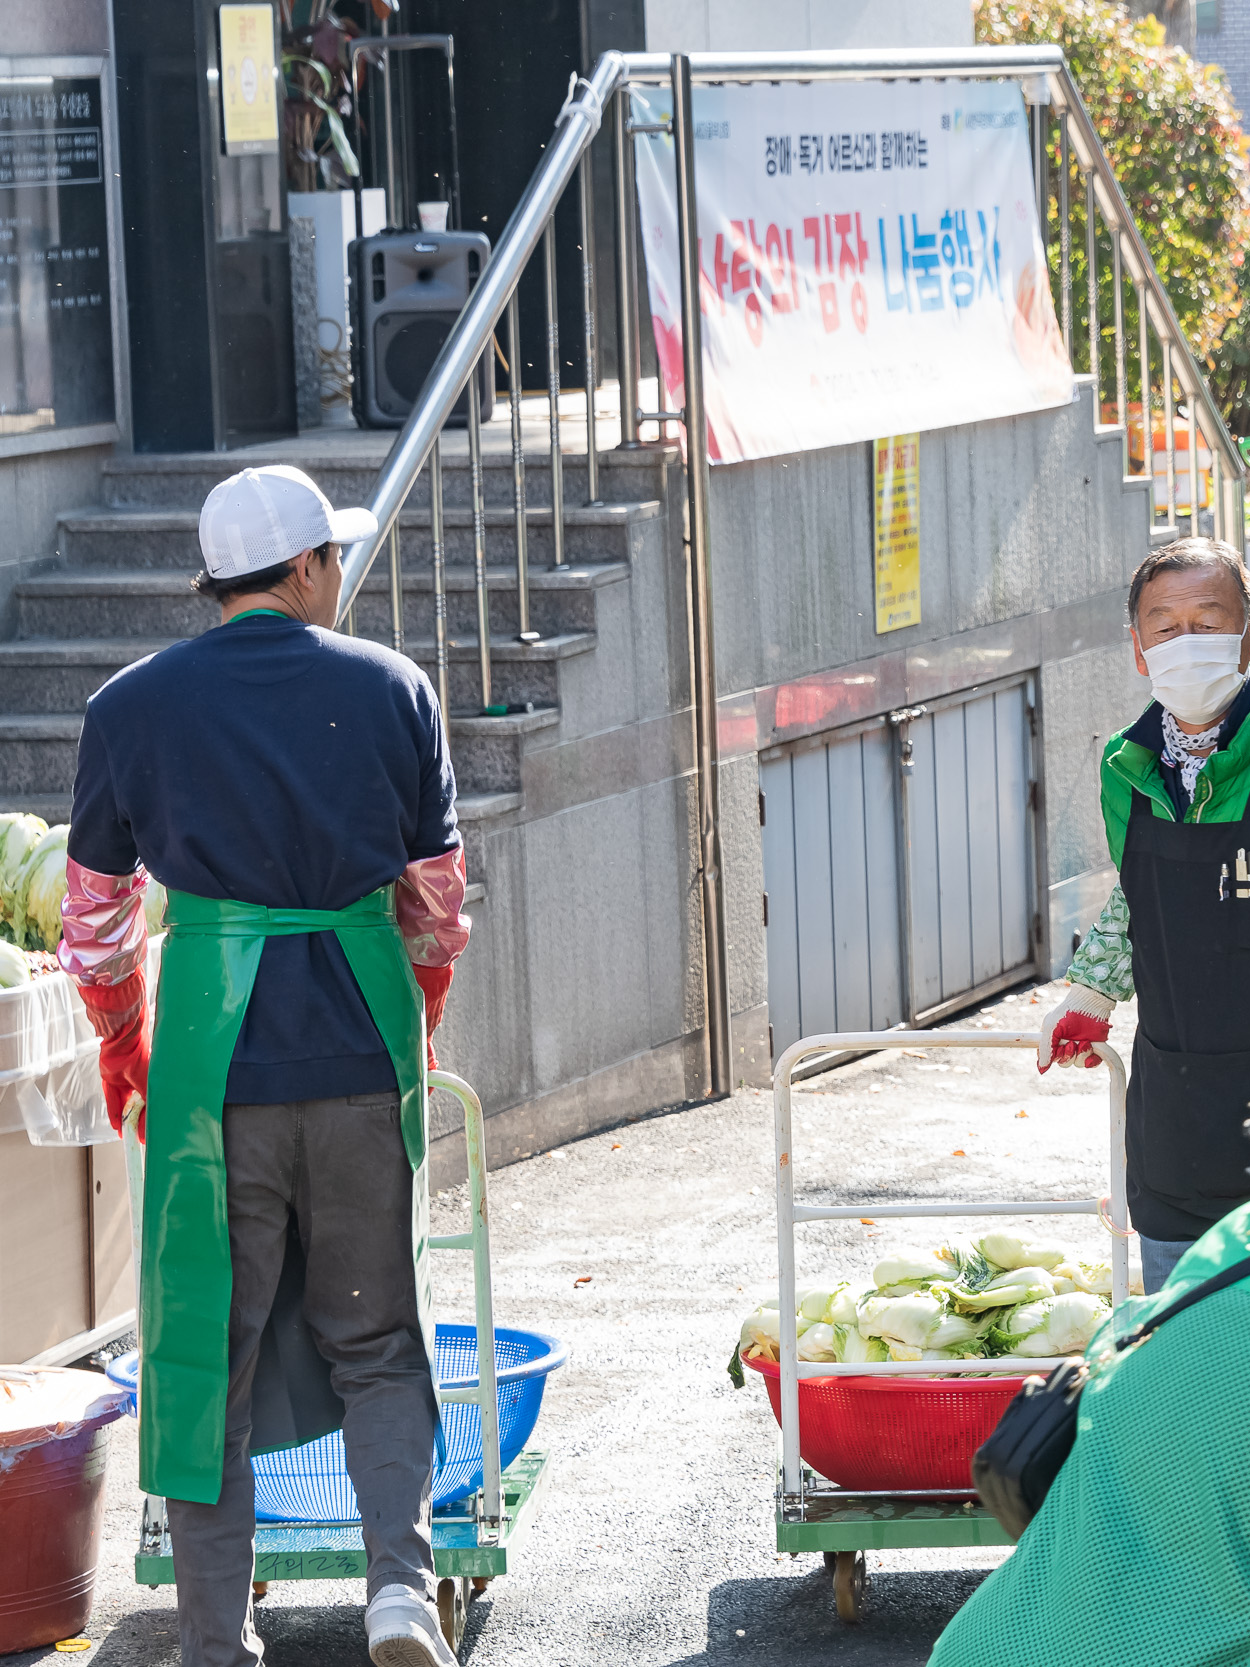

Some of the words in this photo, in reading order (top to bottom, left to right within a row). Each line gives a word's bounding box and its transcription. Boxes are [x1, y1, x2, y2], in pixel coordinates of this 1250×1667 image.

[765, 135, 824, 177] 장애·독거
[828, 132, 877, 174] 어르신과
[881, 130, 929, 171] 함께하는
[803, 211, 869, 335] 김장
[878, 206, 1004, 315] 나눔행사
